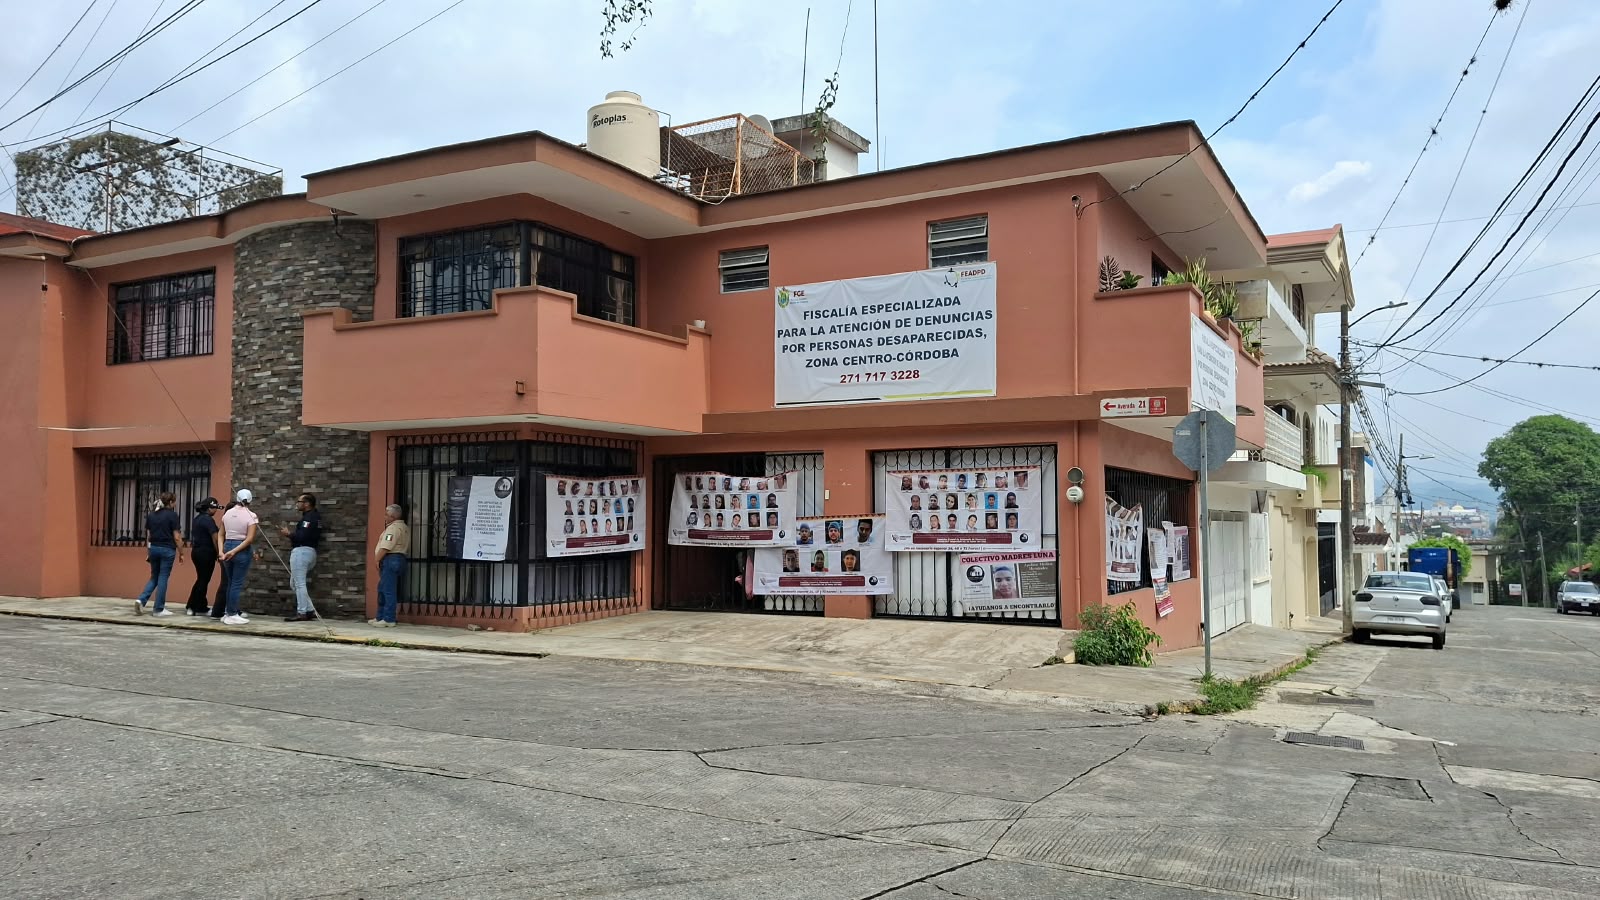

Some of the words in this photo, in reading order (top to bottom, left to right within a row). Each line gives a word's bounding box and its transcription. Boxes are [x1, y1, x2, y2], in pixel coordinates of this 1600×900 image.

[592, 114, 627, 128] Rotoplas
[960, 268, 986, 277] FEADPD
[803, 305, 858, 320] FISCALÍA
[861, 295, 961, 315] ESPECIALIZADA
[777, 327, 807, 338] PARA
[810, 325, 825, 336] LA
[829, 318, 891, 334] ATENCIÓN
[895, 317, 911, 328] DE
[915, 309, 993, 327] DENUNCIAS
[782, 342, 806, 353] POR
[809, 336, 873, 352] PERSONAS
[877, 327, 987, 347] DESAPARECIDAS,
[805, 357, 839, 368] ZONA
[842, 347, 959, 366] CENTRO-CÓRDOBA
[840, 374, 860, 384] 271
[865, 371, 886, 382] 717
[890, 369, 920, 380] 3228
[1138, 400, 1146, 408] 21
[961, 555, 1000, 563] COLECTIVO
[1001, 552, 1032, 561] MADRES
[1033, 551, 1054, 559] LUNA
[1009, 602, 1055, 610] ENCONTRARLO
